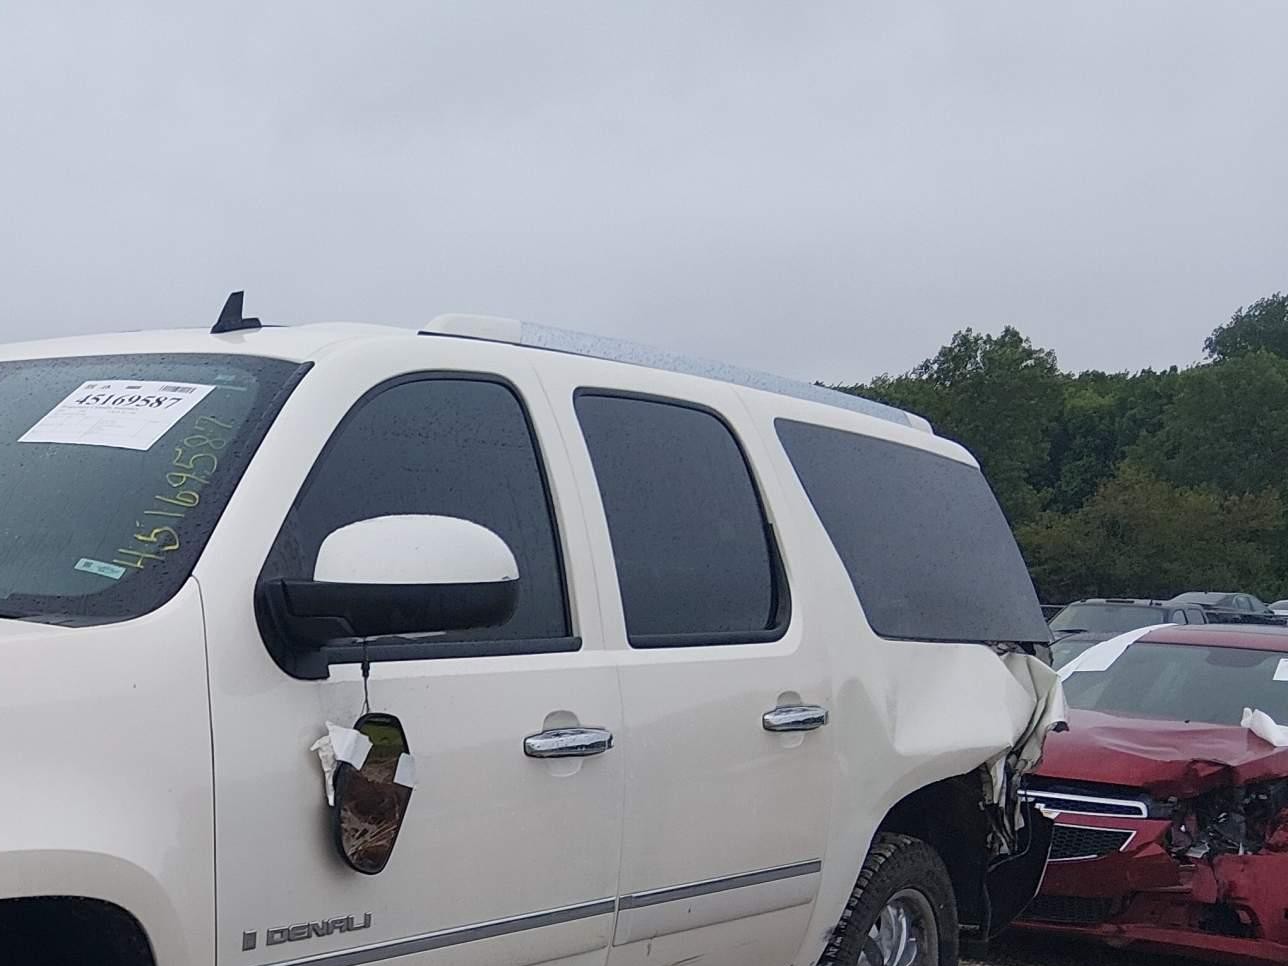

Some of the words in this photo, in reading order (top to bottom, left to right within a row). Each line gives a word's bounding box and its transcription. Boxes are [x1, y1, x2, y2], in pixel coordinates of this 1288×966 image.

[76, 393, 184, 410] 45169587
[112, 415, 233, 569] 45169587
[266, 912, 372, 946] DENALI
